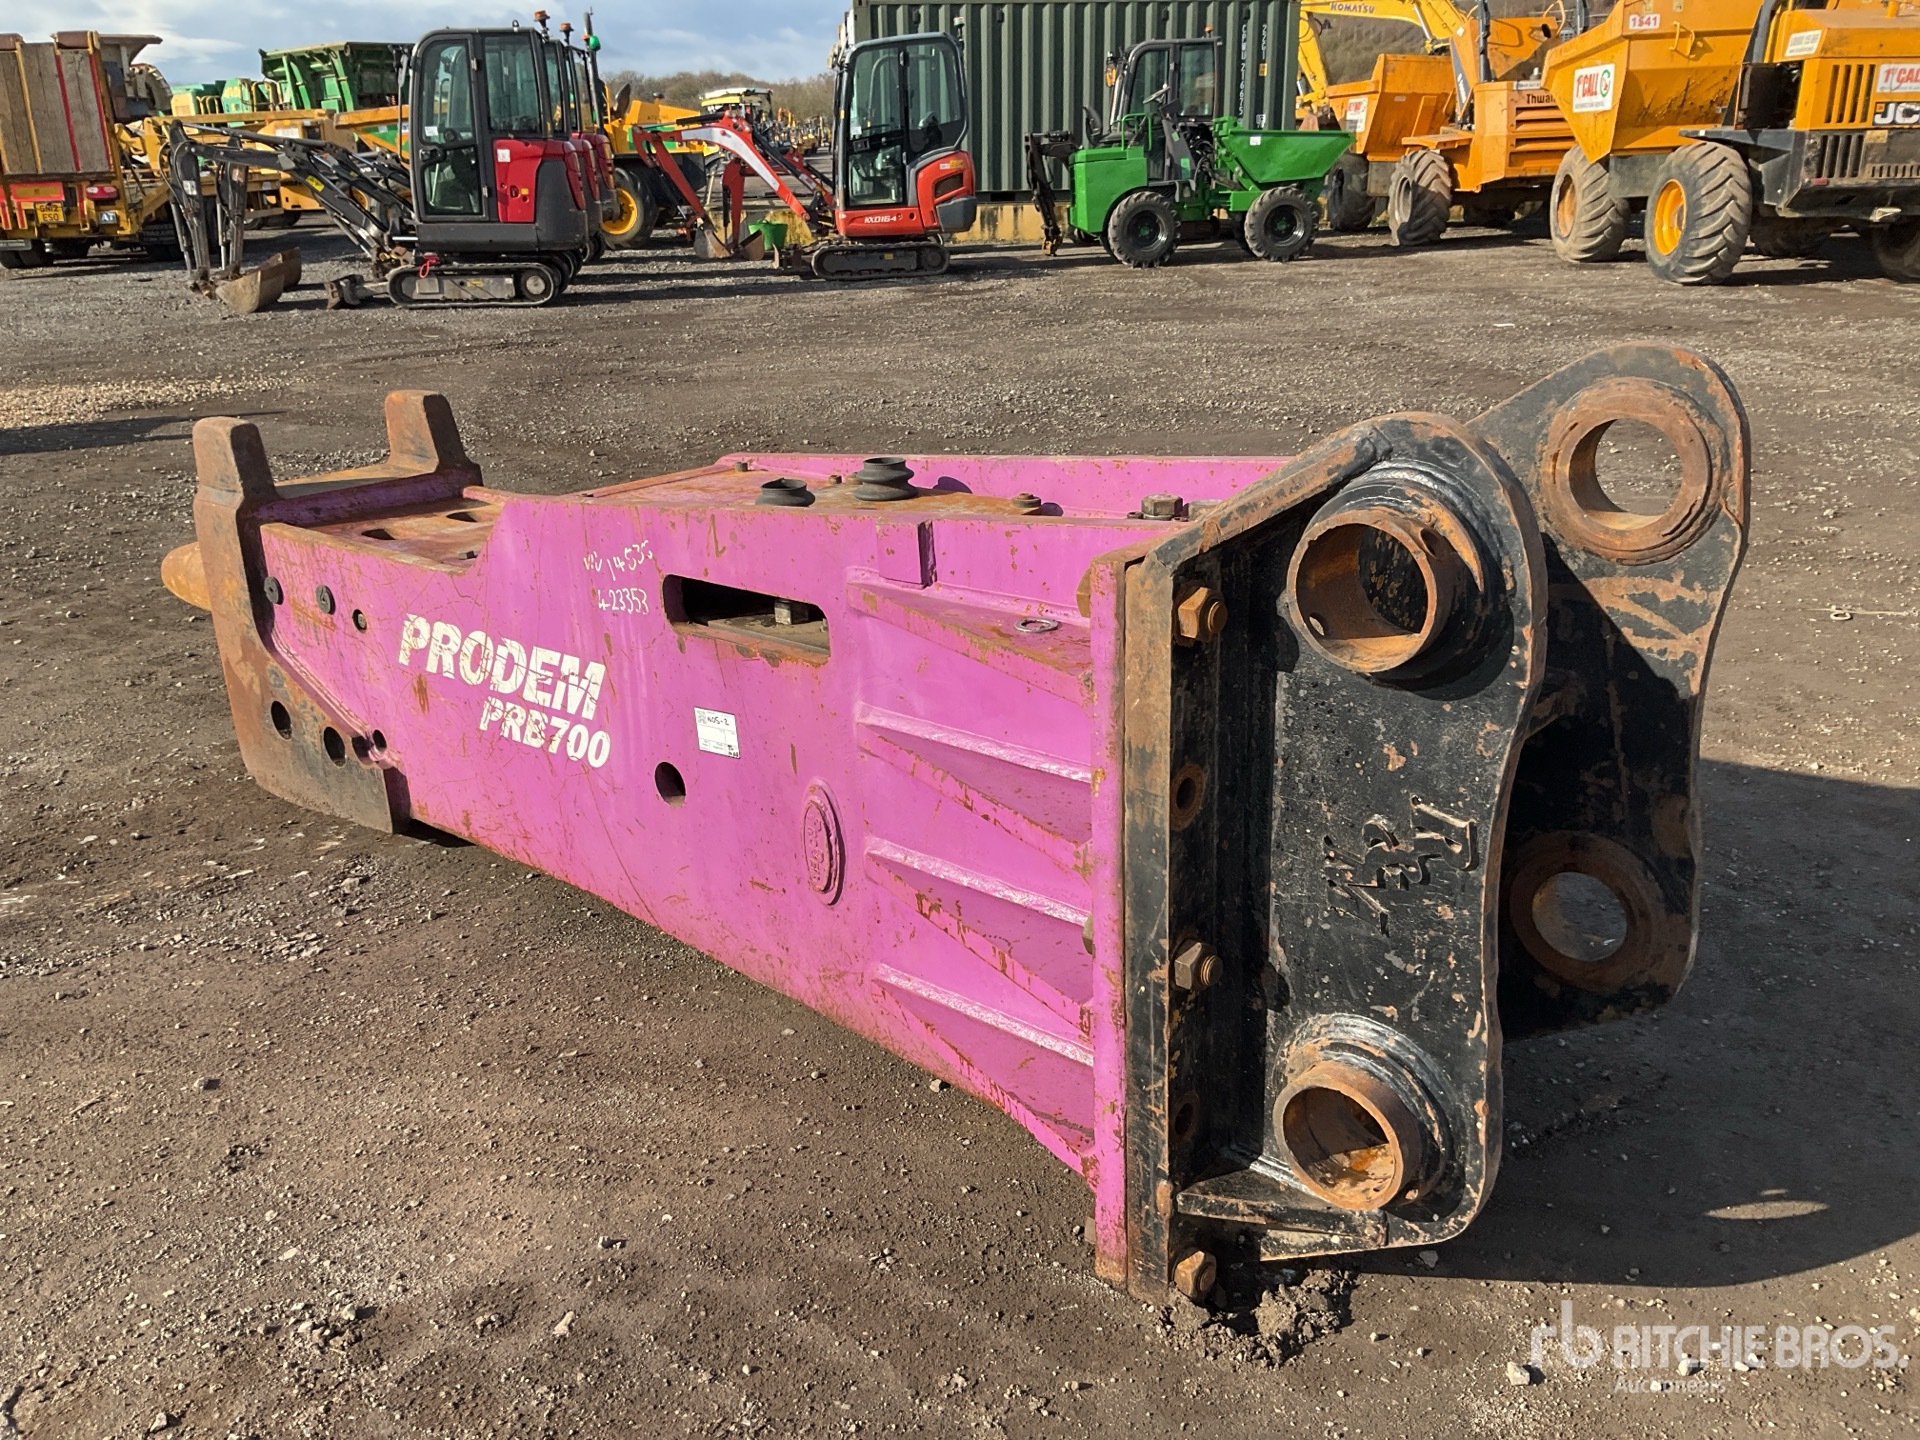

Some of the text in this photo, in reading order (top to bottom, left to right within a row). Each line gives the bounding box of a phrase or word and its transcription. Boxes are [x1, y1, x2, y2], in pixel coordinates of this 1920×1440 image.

[1330, 2, 1375, 14] KOMATSU
[597, 587, 649, 615] 423353
[398, 612, 607, 721] PRODEM
[479, 695, 611, 769] PRB700
